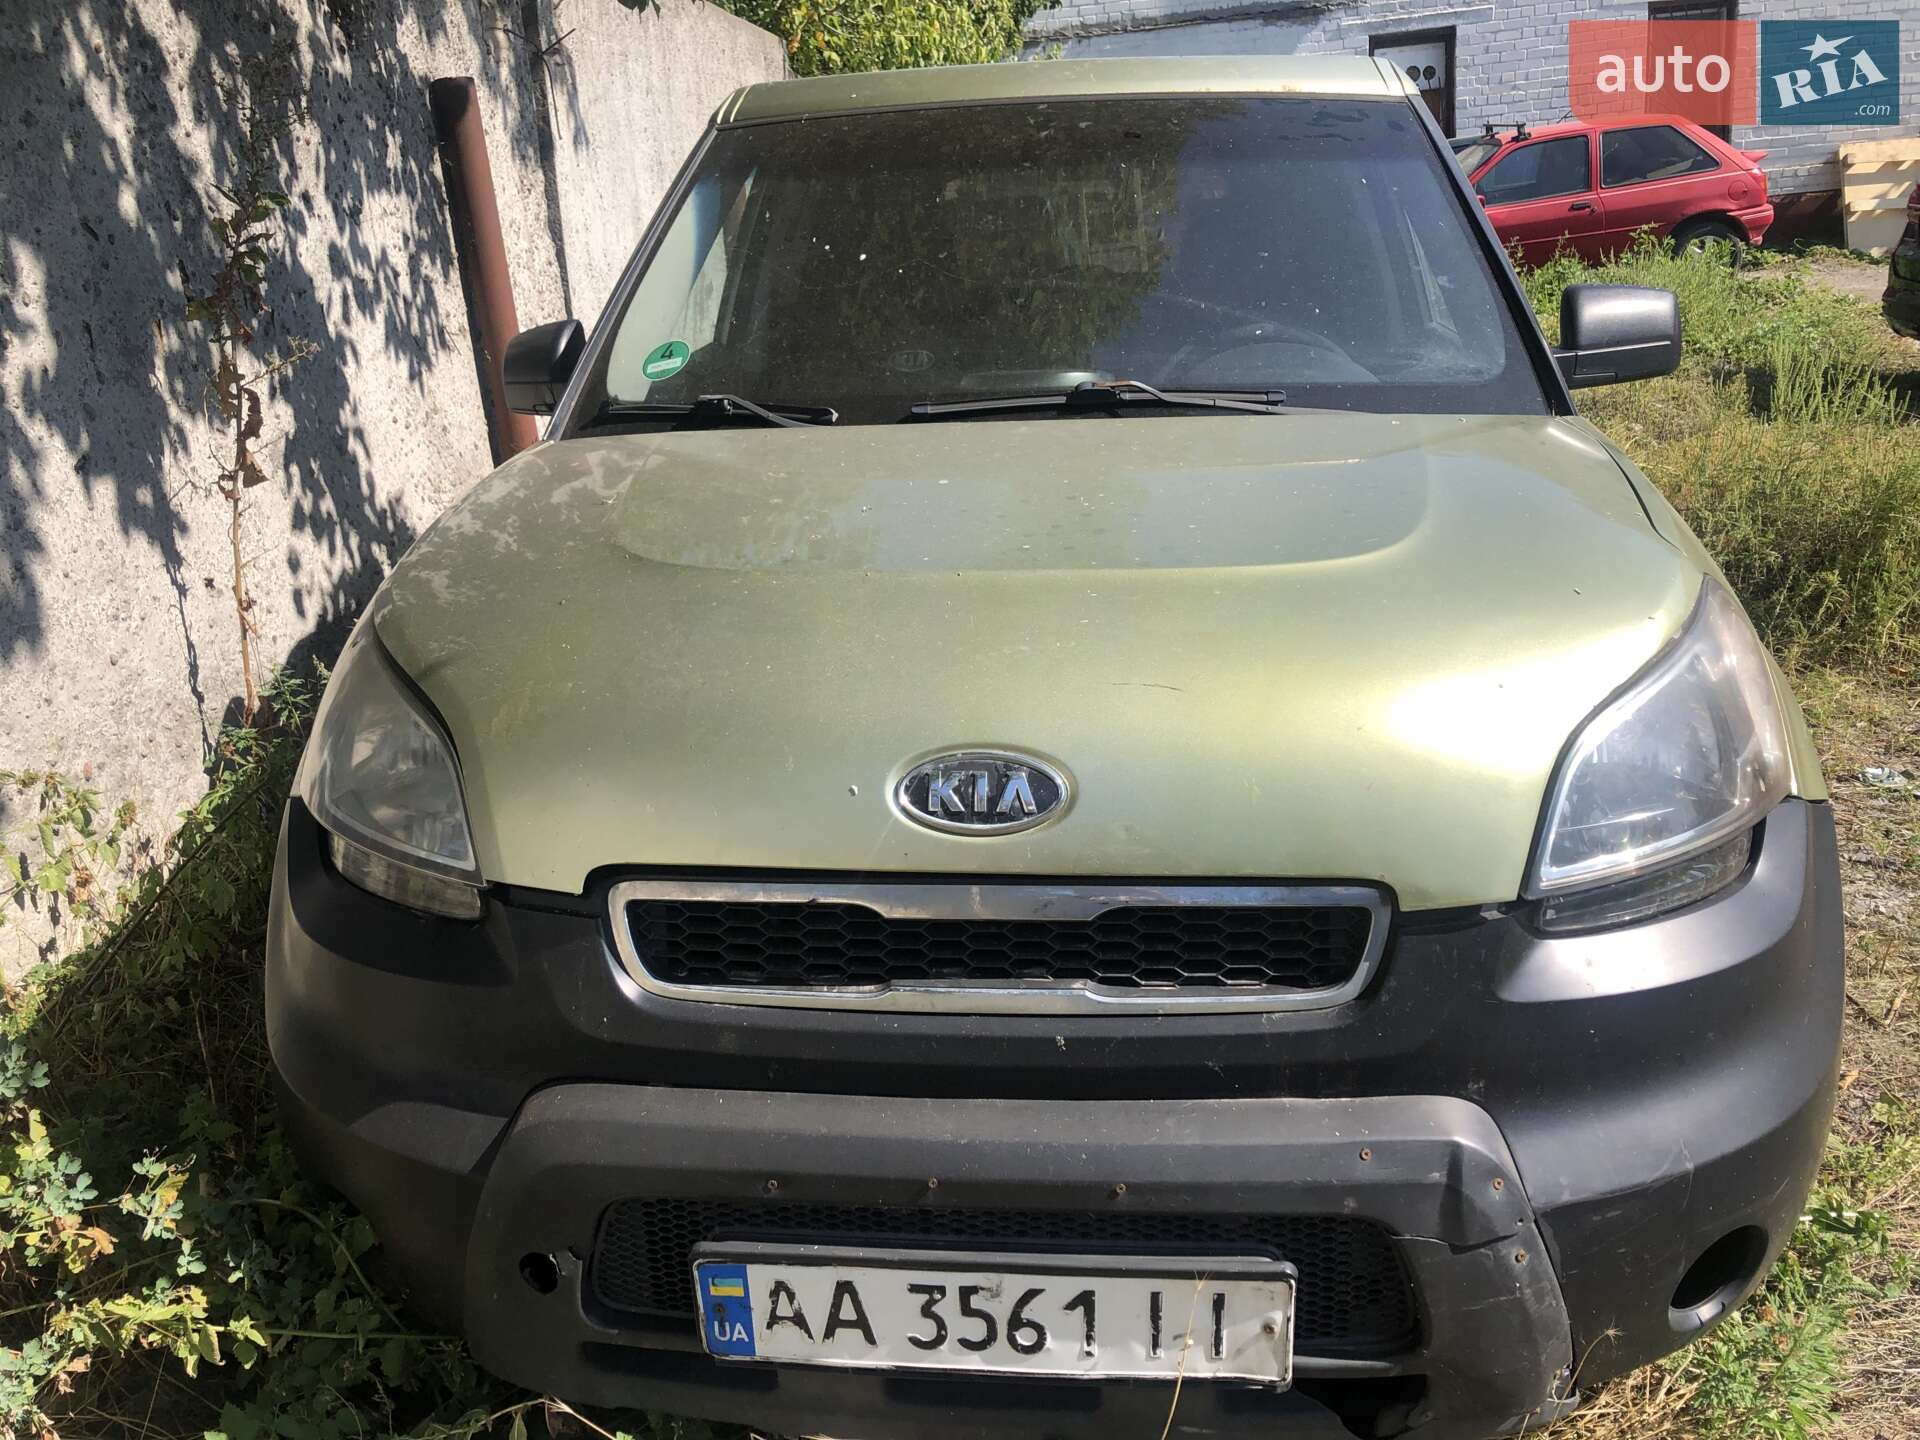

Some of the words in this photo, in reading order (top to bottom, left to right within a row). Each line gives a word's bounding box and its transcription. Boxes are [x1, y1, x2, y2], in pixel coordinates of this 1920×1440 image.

[660, 343, 674, 359] 4
[928, 770, 1038, 814] KIA
[714, 1320, 749, 1342] UA
[763, 1279, 879, 1348] AA
[906, 1283, 1098, 1359] 3561
